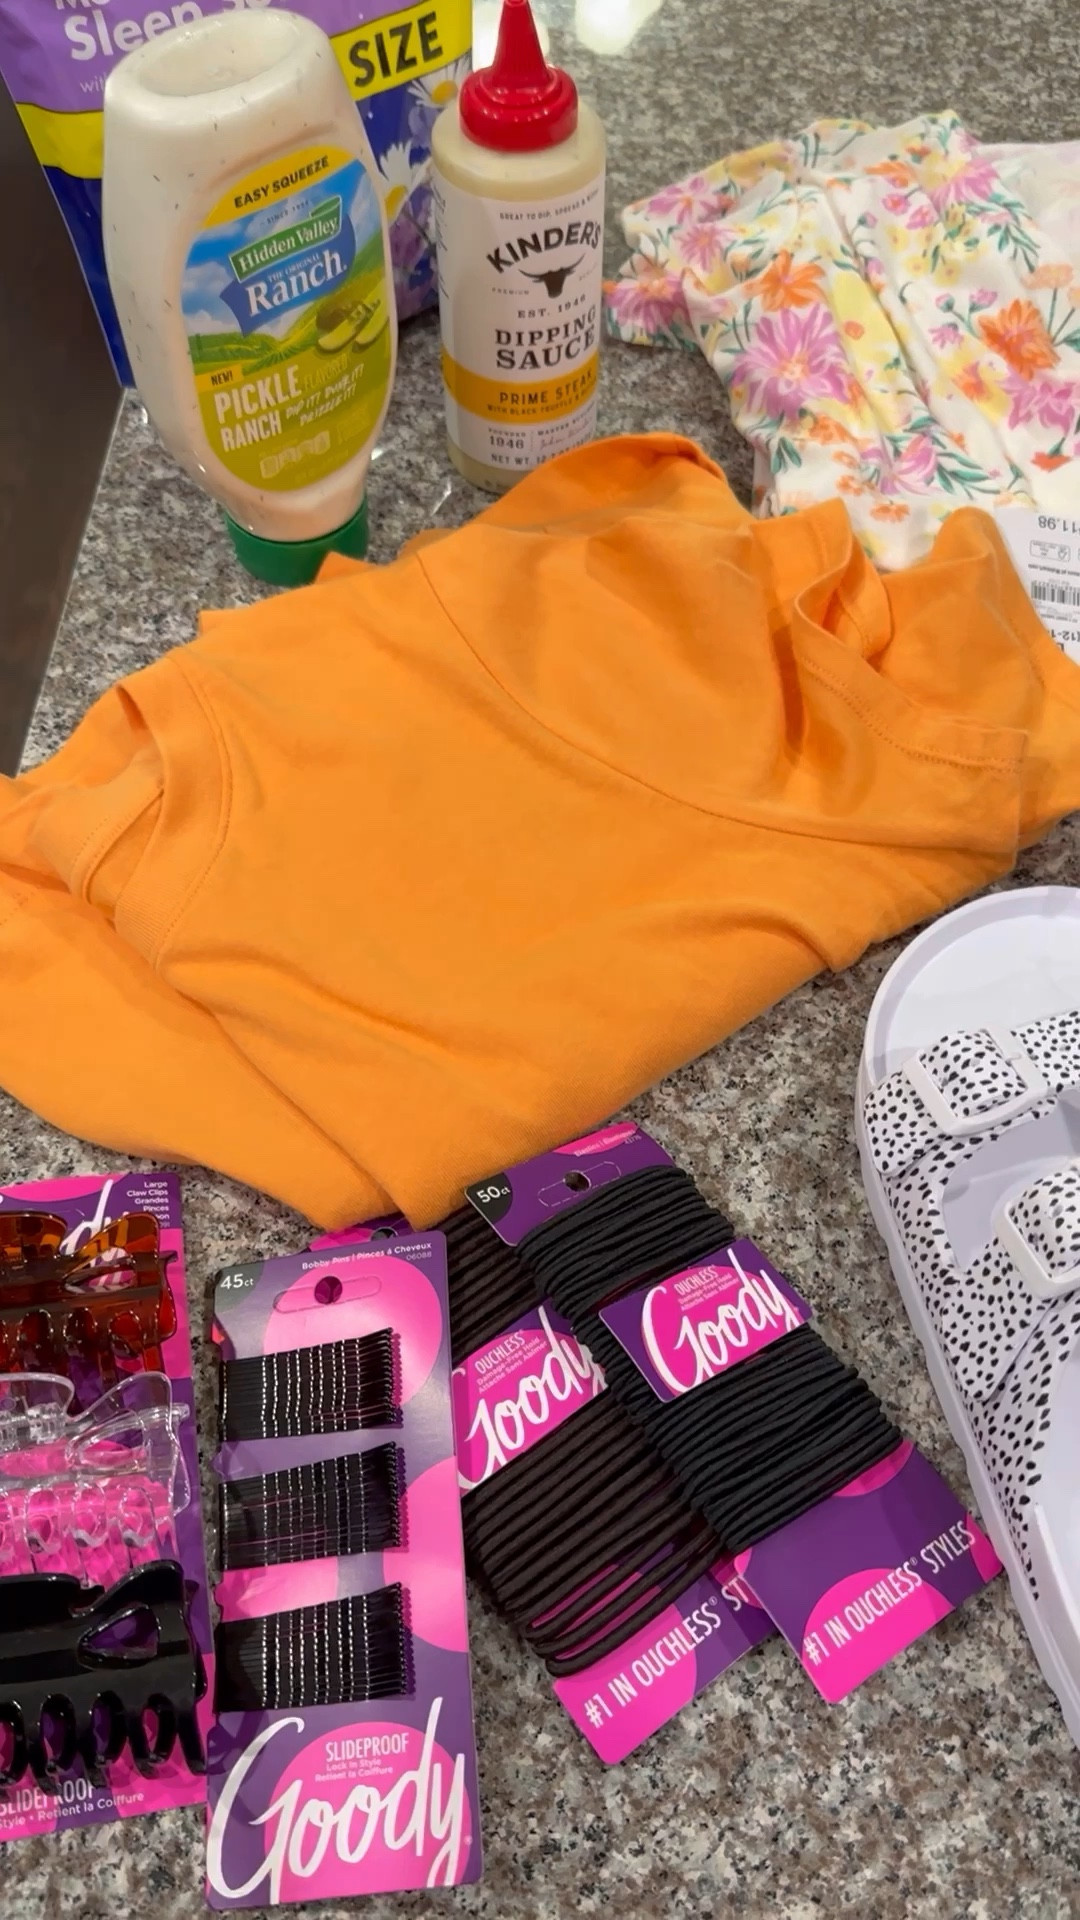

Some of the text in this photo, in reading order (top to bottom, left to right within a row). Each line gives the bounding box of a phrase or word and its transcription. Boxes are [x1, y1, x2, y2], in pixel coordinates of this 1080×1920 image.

[65, 0, 202, 61] Sleep
[349, 12, 443, 88] SIZE
[81, 75, 105, 93] wit
[235, 156, 329, 208] EASY SQUEEZE
[500, 211, 523, 221] GREAT
[526, 212, 537, 221] TO
[238, 217, 338, 273] Hidden Valley
[486, 221, 601, 274] KINDER'S
[268, 253, 320, 283] THE ORIGINAL
[495, 305, 596, 346] DIPPING
[518, 308, 550, 319] EST.
[496, 325, 595, 370] SAUCE
[211, 370, 233, 386] NEW!
[500, 391, 548, 405] PRIME
[555, 368, 592, 399] STEAK
[214, 365, 302, 423] PICKLE
[488, 404, 507, 415] WITH
[510, 406, 536, 416] BLACK
[221, 410, 282, 451] RANCH
[490, 436, 524, 449] 1946
[491, 453, 509, 465] NET
[515, 454, 529, 466] WT
[1039, 516, 1080, 534] 11.98
[1048, 629, 1080, 641] (12-1
[127, 1188, 168, 1198] Claw Clips
[144, 1180, 167, 1190] Large
[135, 1196, 168, 1205] Grandes
[143, 1204, 169, 1213] Pinces
[302, 1258, 330, 1270] Bobby
[332, 1254, 350, 1265] Pins
[357, 1249, 385, 1260] Pinces
[395, 1242, 431, 1253] Cheveux
[642, 1248, 802, 1393] Goody
[523, 1337, 539, 1352] Hold
[804, 1631, 830, 1666] #1
[823, 1616, 852, 1647] IN
[920, 1520, 976, 1574] STYLES
[583, 1694, 611, 1728] #1
[608, 1672, 636, 1708] IN
[326, 1733, 409, 1762] SLIDEPROOF
[38, 1804, 80, 1821] Retient
[83, 1801, 94, 1812] la
[98, 1793, 144, 1808] Coiffure
[207, 1698, 465, 1904] Goody
